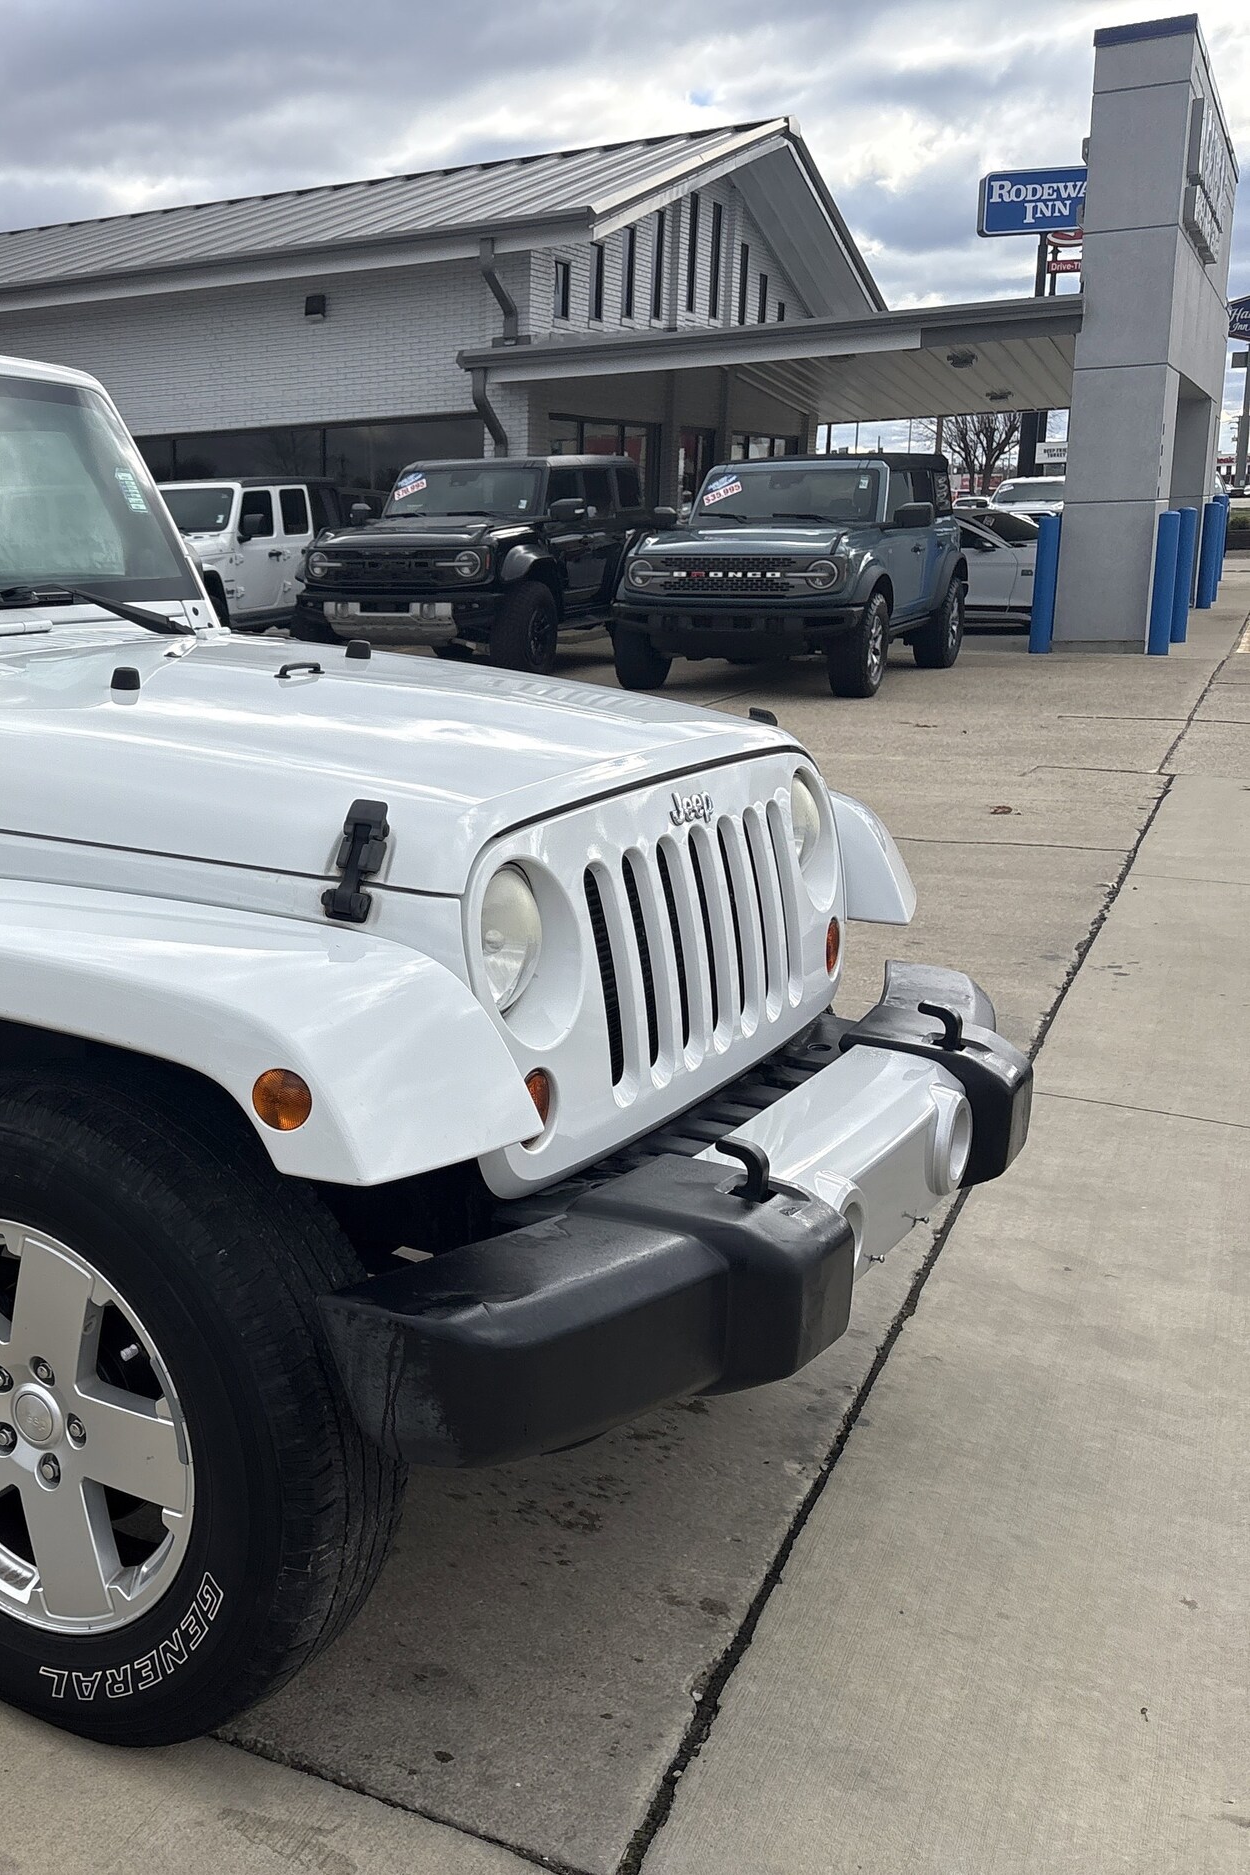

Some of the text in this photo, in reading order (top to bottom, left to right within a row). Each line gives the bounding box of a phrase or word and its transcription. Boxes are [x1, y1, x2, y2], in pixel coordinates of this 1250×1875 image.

[989, 180, 1087, 203] RODEWA
[1023, 200, 1072, 224] INN
[669, 791, 714, 827] Jeep
[38, 1570, 225, 1701] GENERAL
